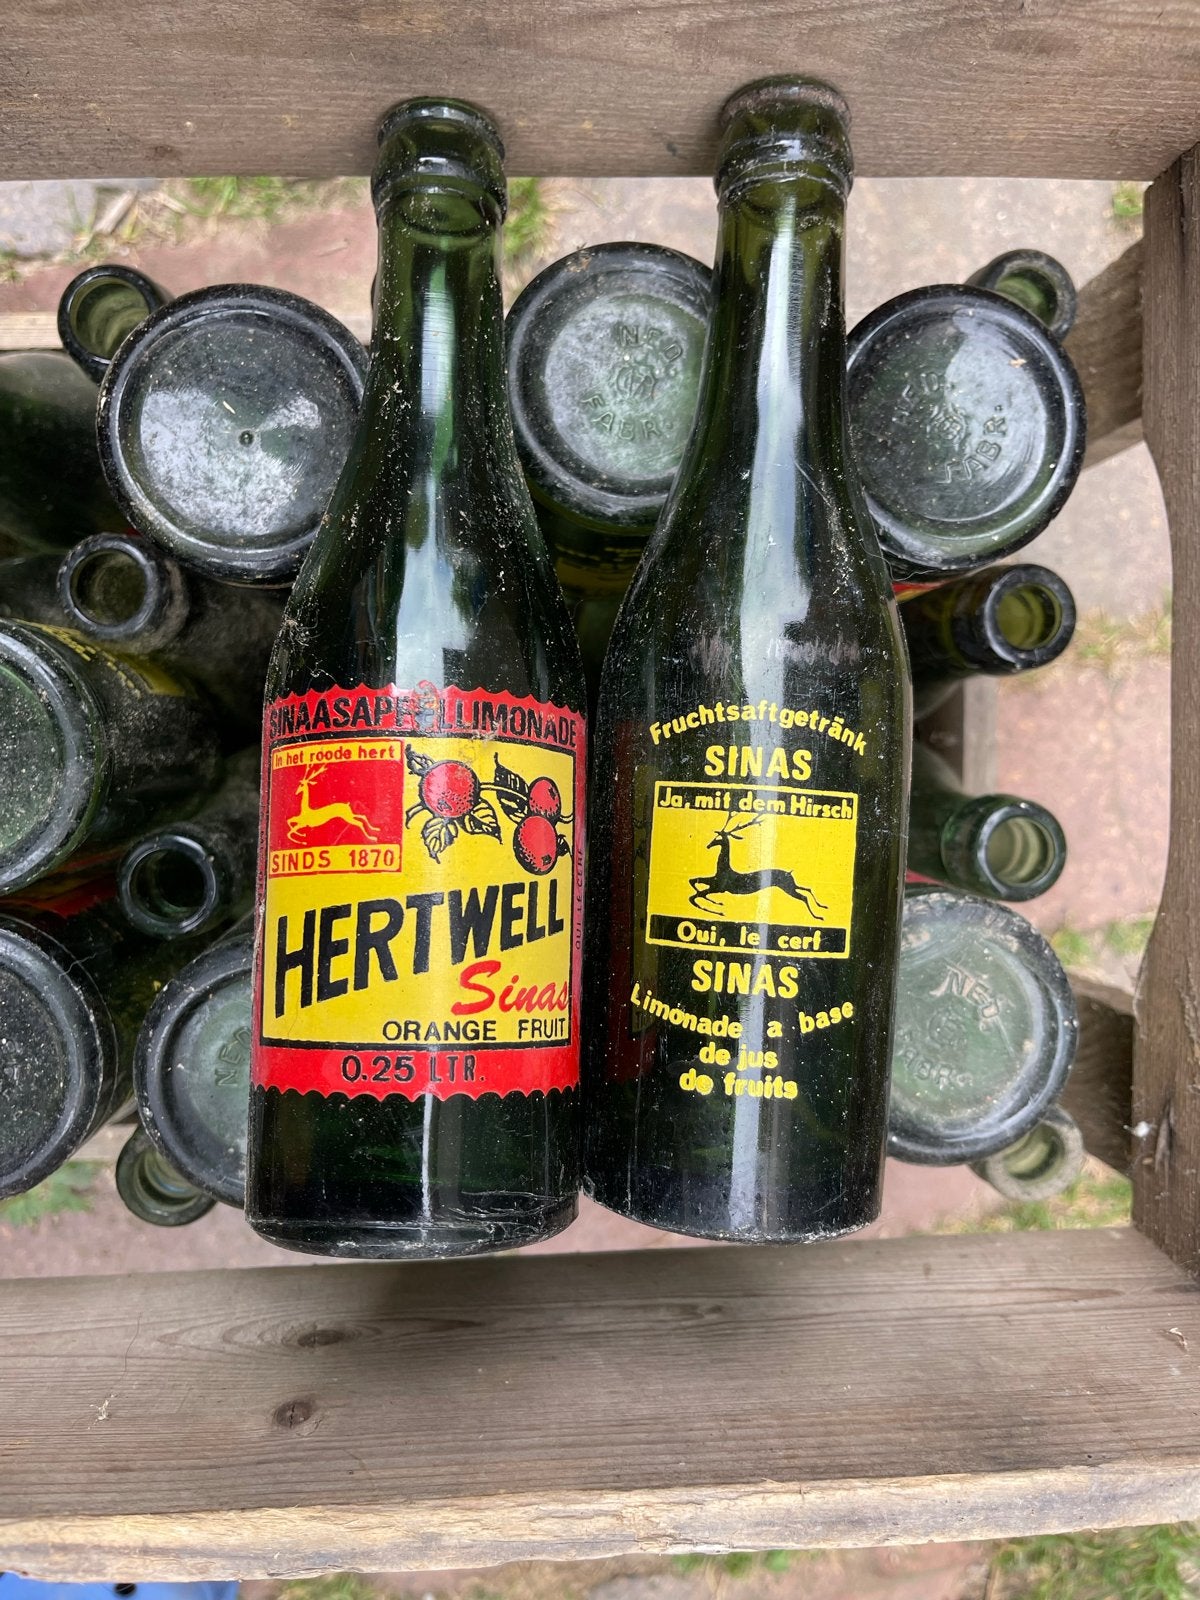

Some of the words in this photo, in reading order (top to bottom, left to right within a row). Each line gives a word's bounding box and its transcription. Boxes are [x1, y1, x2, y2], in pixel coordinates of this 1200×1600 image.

[649, 700, 867, 756] Fruchtsaftgetränk
[285, 749, 305, 766] het
[309, 747, 353, 762] roode
[358, 744, 395, 760] hert
[704, 745, 813, 780] SINAS
[660, 787, 690, 808] Ja,
[695, 791, 731, 809] mit
[739, 792, 784, 813] dem
[790, 795, 853, 819] Hirsch
[271, 851, 331, 873] SINDS
[348, 848, 395, 868] 1870
[275, 878, 564, 1019] HERTWELL
[677, 921, 726, 947] Oui,
[741, 927, 760, 946] le
[778, 930, 822, 950] cerf
[450, 959, 569, 1016] Sinas
[691, 959, 799, 999] SINAS
[630, 982, 743, 1039] Limonade
[799, 1000, 855, 1035] base
[382, 1020, 497, 1042] ORANGE
[519, 1020, 567, 1040] FRUIT
[341, 1055, 416, 1083] 0.25
[428, 1056, 486, 1083] LTR.
[699, 1042, 730, 1066] de
[737, 1045, 779, 1069] jus
[679, 1068, 713, 1095] de
[724, 1071, 799, 1099] fruits
